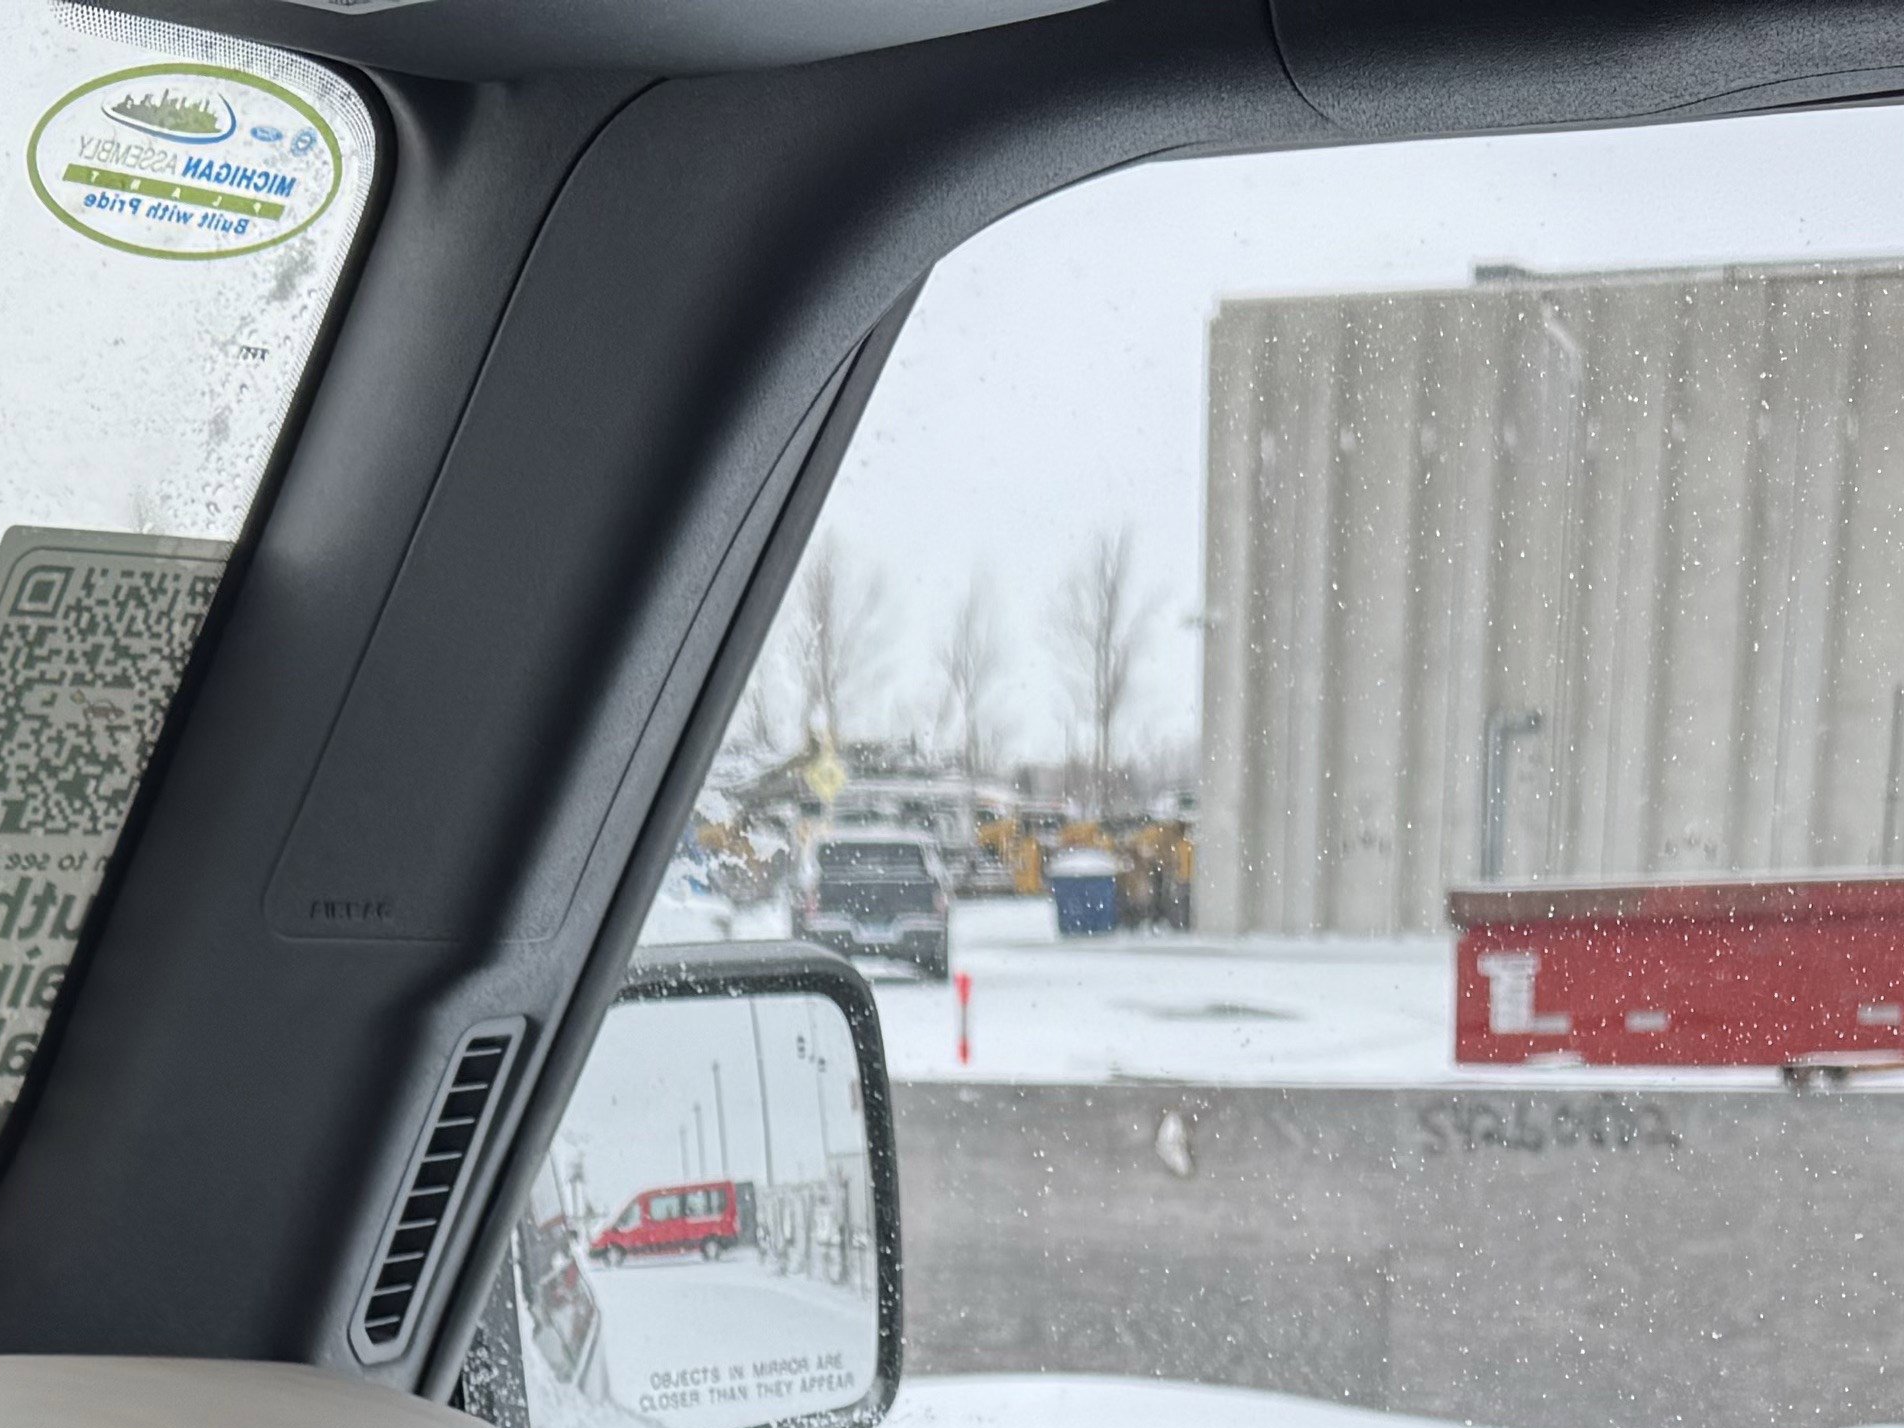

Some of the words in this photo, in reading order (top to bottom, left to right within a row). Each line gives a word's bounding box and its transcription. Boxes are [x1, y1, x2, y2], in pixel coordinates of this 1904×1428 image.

[649, 1364, 721, 1390] OBJECTS
[728, 1364, 746, 1380] IN
[753, 1356, 810, 1377] MIRROR
[815, 1353, 844, 1370] ARE
[639, 1389, 700, 1413] CLOSER
[708, 1385, 750, 1403] THAN
[756, 1378, 793, 1398] THEY
[799, 1371, 856, 1393] APPEAR
